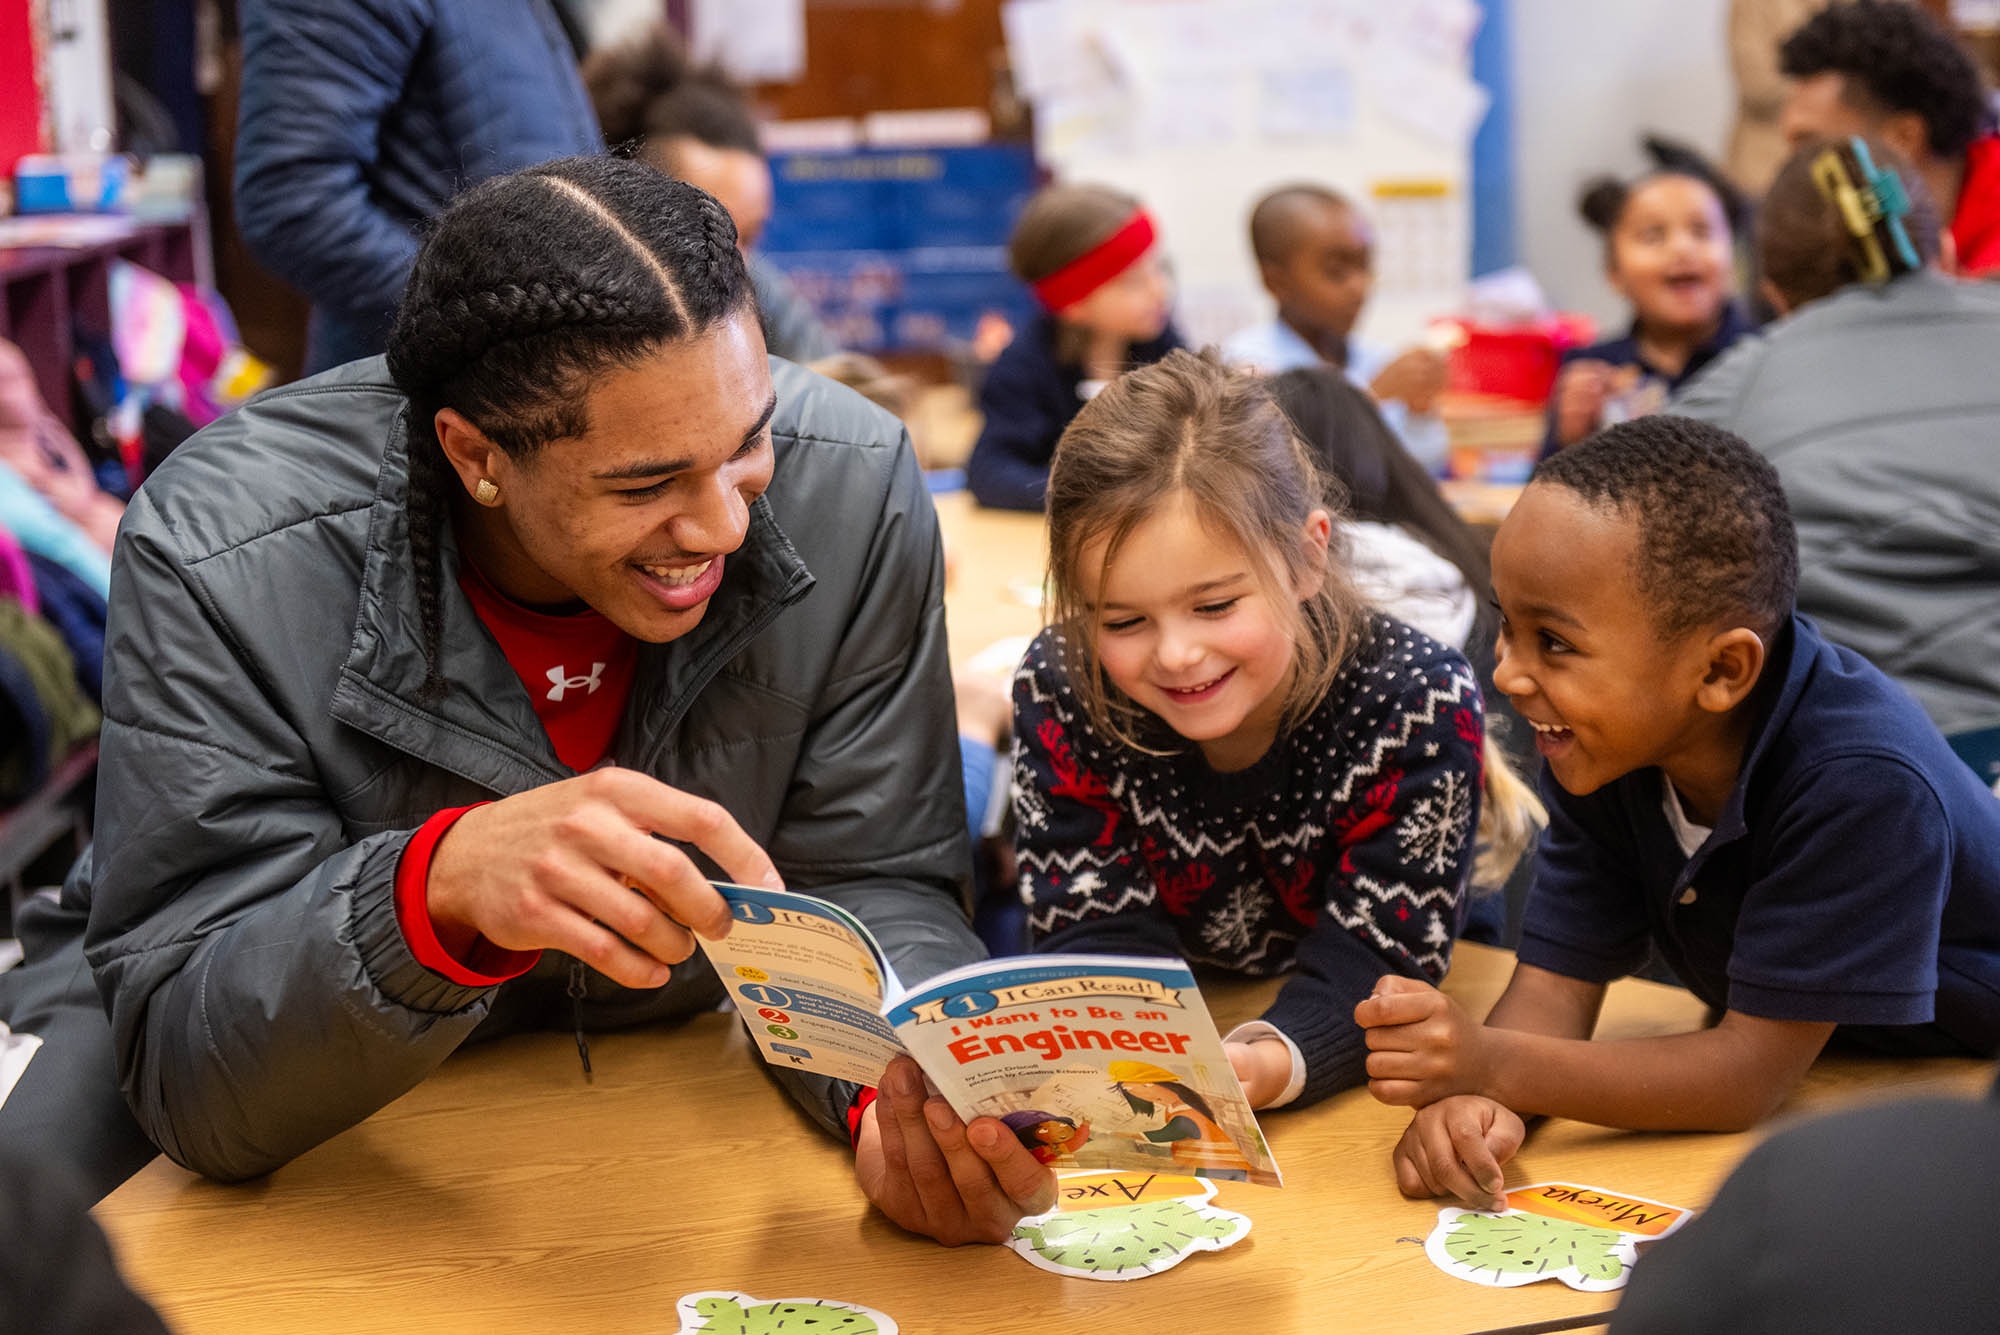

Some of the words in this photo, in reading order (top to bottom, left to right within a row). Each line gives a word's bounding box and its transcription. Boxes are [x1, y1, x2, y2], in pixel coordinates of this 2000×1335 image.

[738, 904, 758, 920] 1
[780, 912, 791, 923] I
[796, 915, 843, 938] Can
[752, 986, 777, 1005] 1
[794, 993, 823, 1003] Short
[959, 996, 982, 1012] 1
[1006, 991, 1016, 1001] I
[1021, 986, 1074, 999] Can
[1078, 980, 1152, 995] Read!
[763, 1008, 784, 1023] 2
[951, 1026, 961, 1036] I
[968, 1011, 1040, 1028] Want
[1050, 1007, 1078, 1019] to
[1087, 1006, 1123, 1021] Be
[1135, 1010, 1169, 1021] an
[775, 1025, 792, 1039] 3
[947, 1025, 1192, 1065] Engineer
[964, 1074, 976, 1083] by
[977, 1067, 1003, 1078] Laura
[1004, 1063, 1039, 1072] Driscoll
[968, 1074, 1004, 1088] pictures
[1541, 1185, 1672, 1227] Mireya
